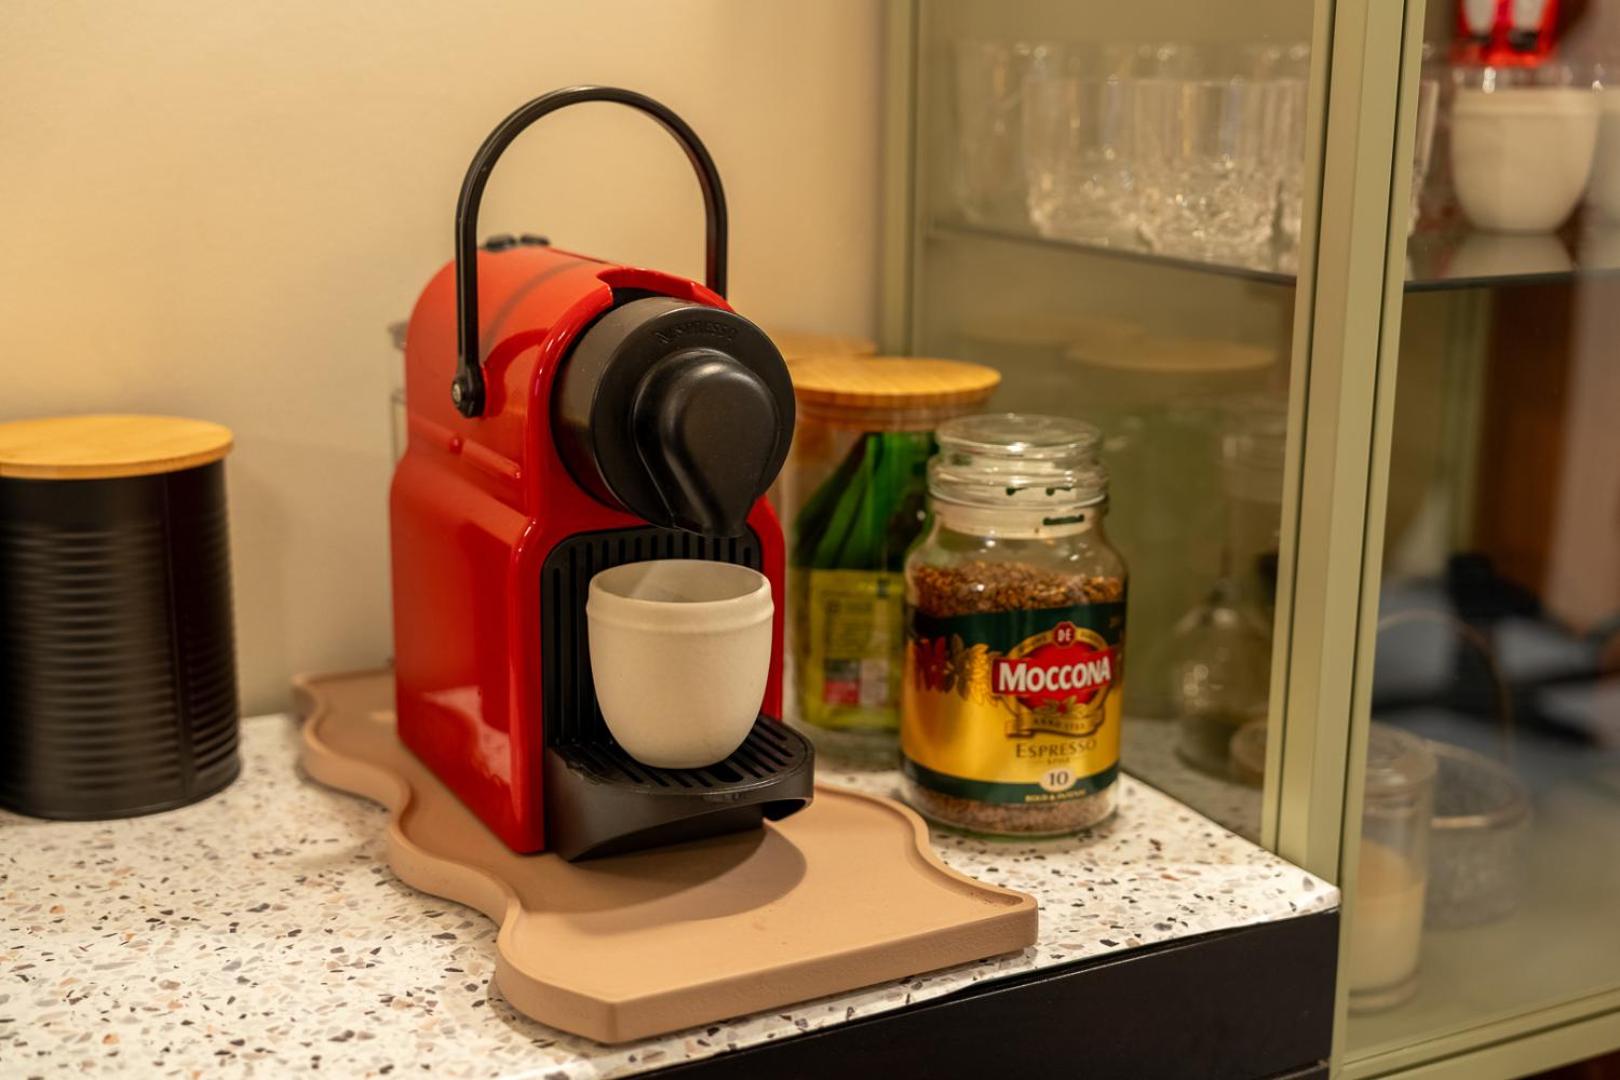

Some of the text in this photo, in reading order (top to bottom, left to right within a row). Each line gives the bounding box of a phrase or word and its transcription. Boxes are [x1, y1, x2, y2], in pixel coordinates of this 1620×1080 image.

[1057, 628, 1072, 643] DE
[998, 655, 1112, 693] MOCCONA
[1015, 738, 1098, 759] ESPRESSO
[1049, 770, 1070, 787] 10
